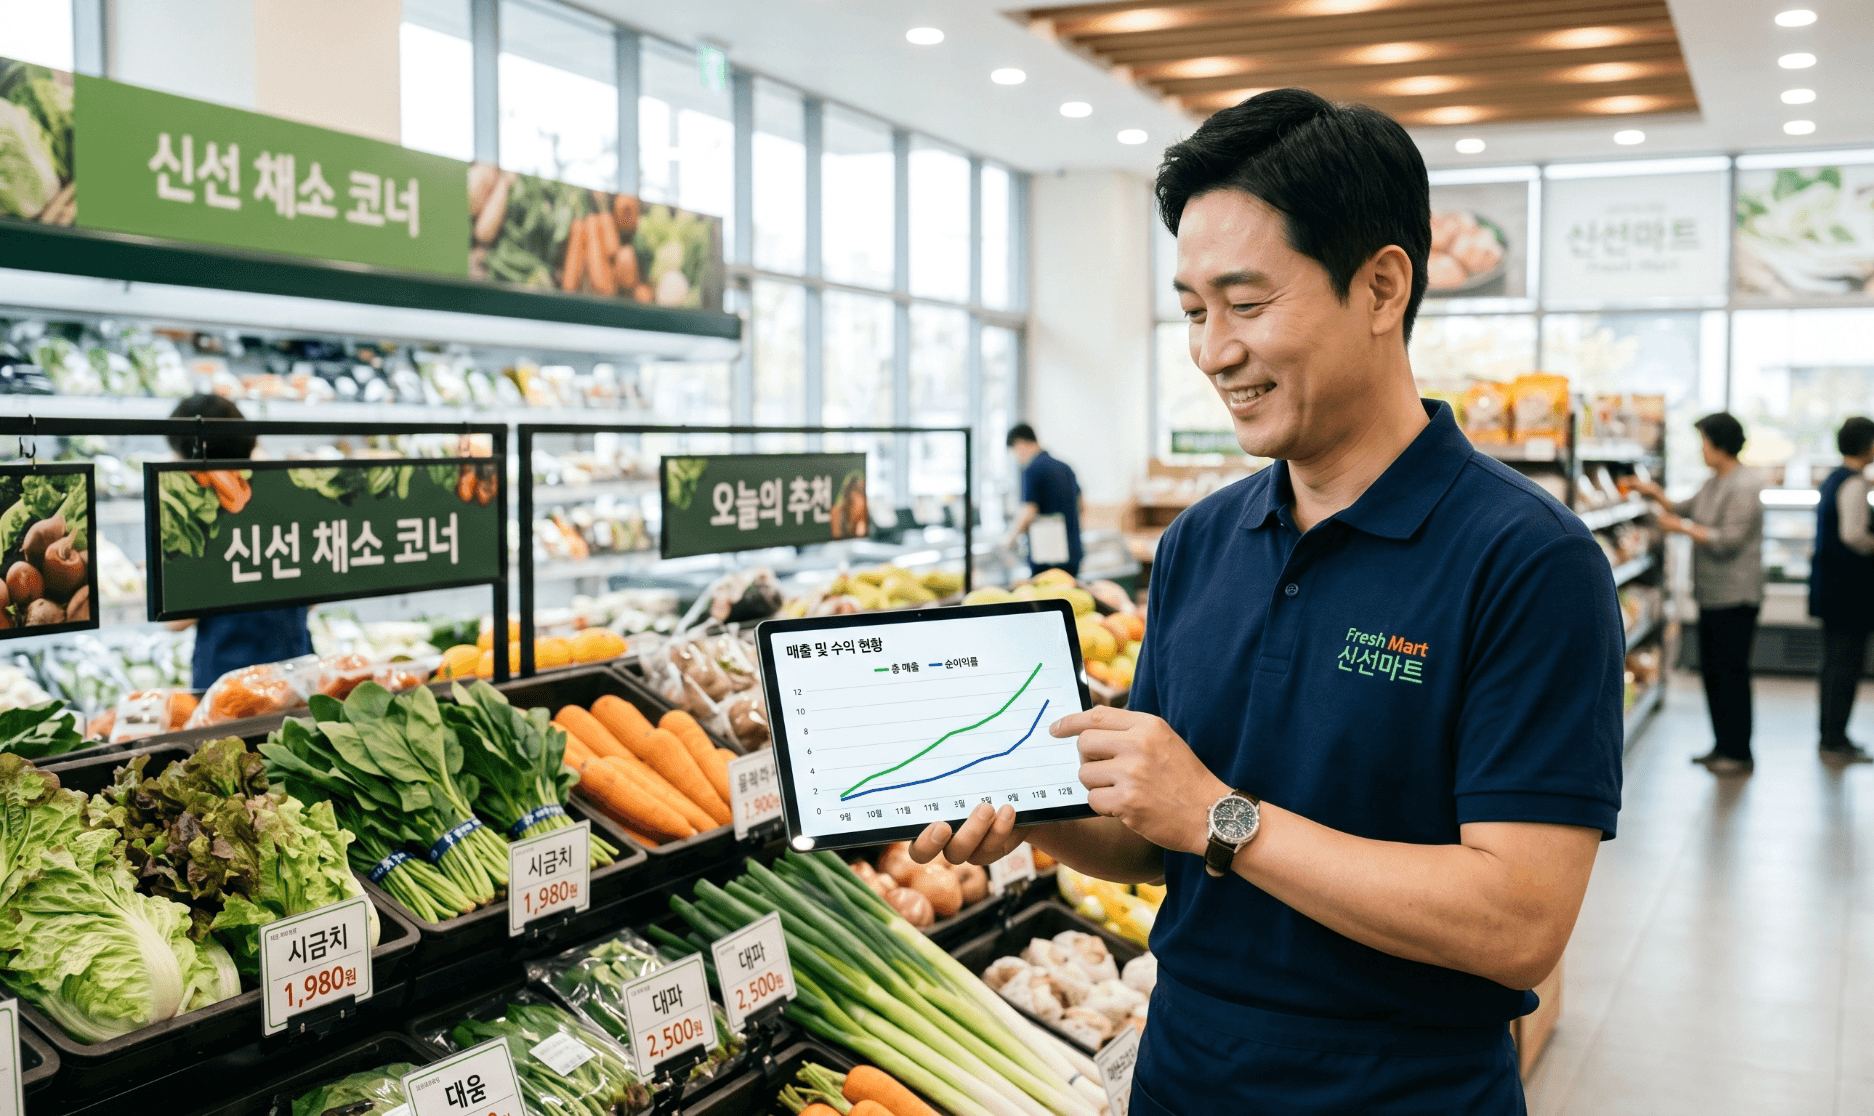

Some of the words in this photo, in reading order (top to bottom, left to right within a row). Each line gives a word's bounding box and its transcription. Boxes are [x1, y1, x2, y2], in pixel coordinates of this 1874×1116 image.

[149, 132, 242, 210] 신선
[253, 151, 338, 219] 채소
[345, 170, 420, 238] 코너
[709, 477, 783, 531] 오늘의
[787, 475, 832, 526] 추천
[223, 521, 301, 583] 신선
[312, 519, 386, 574] 채소
[393, 512, 459, 565] 코너
[786, 643, 812, 659] 매출
[815, 641, 828, 657] 및
[831, 640, 856, 655] 수익
[858, 637, 883, 653] 현황
[1345, 627, 1387, 649] Fresh
[1387, 635, 1429, 658] Mart
[891, 663, 900, 675] 총
[901, 661, 920, 673] 매출
[1337, 645, 1423, 684] 신선마트
[793, 688, 802, 696] 12
[796, 708, 806, 716] 10
[803, 728, 809, 736] 8
[528, 845, 572, 877] 시금치
[523, 880, 578, 916] 1,980원
[288, 923, 348, 964] 시금치
[738, 941, 766, 970] 대파
[284, 965, 357, 1009] 1,980원
[652, 983, 684, 1015] 대파
[646, 1017, 704, 1058] 2,500원
